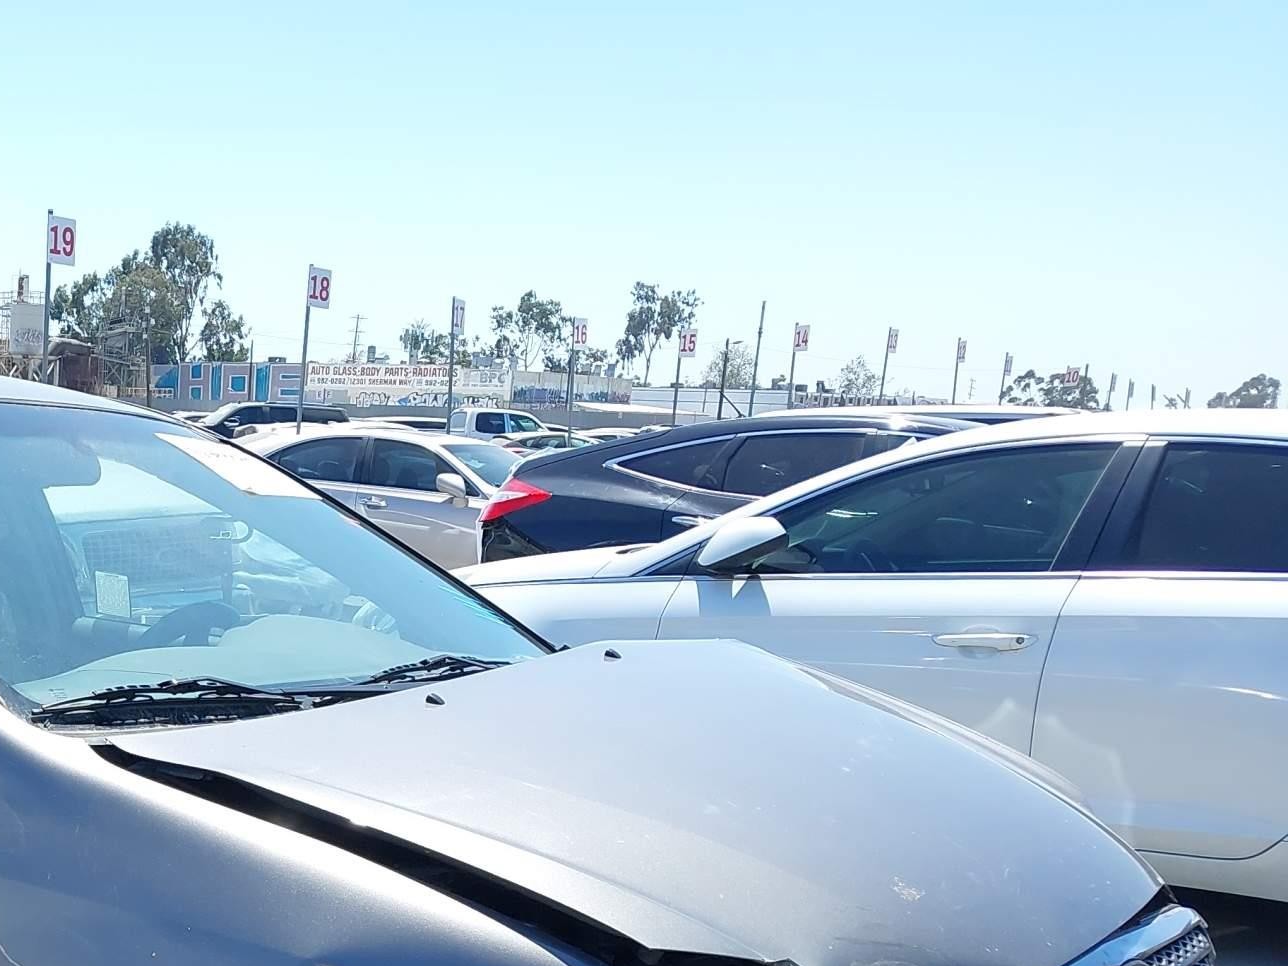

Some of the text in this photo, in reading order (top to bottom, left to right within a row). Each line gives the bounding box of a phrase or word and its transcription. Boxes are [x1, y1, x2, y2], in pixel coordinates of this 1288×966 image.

[49, 224, 75, 257] 19
[309, 274, 330, 302] 18
[454, 304, 465, 329] 17
[574, 324, 588, 345] 16
[680, 333, 697, 353] 15
[795, 329, 809, 348] 14
[310, 365, 330, 376] AUTO
[1065, 370, 1080, 384] 10
